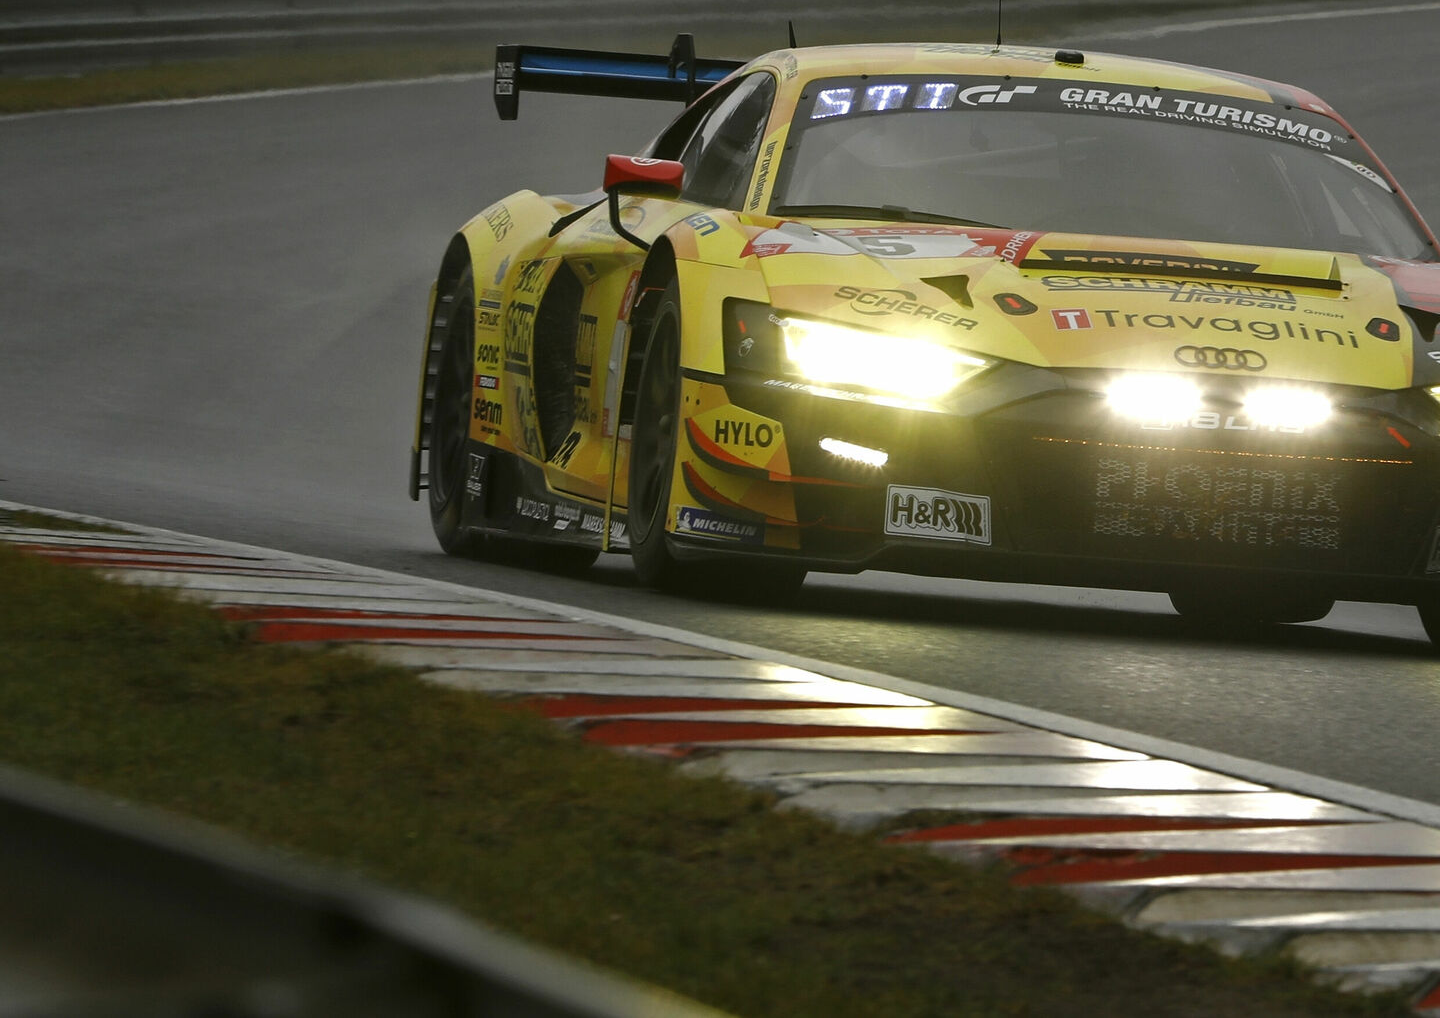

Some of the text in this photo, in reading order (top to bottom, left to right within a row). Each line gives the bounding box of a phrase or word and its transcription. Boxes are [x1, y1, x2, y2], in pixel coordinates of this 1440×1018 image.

[1059, 87, 1333, 145] GRAN TURISMO
[1063, 102, 1333, 152] THE REAL DRIVING SIMULATOR
[856, 235, 917, 257] 5
[1041, 274, 1297, 302] SCHRAMM
[1168, 288, 1298, 312] Tiefbau
[833, 285, 979, 331] SCHERER
[1094, 308, 1360, 349] Travaglini
[714, 418, 774, 448] HYLO
[692, 517, 758, 537] MICHELIN
[892, 494, 954, 532] H&R
